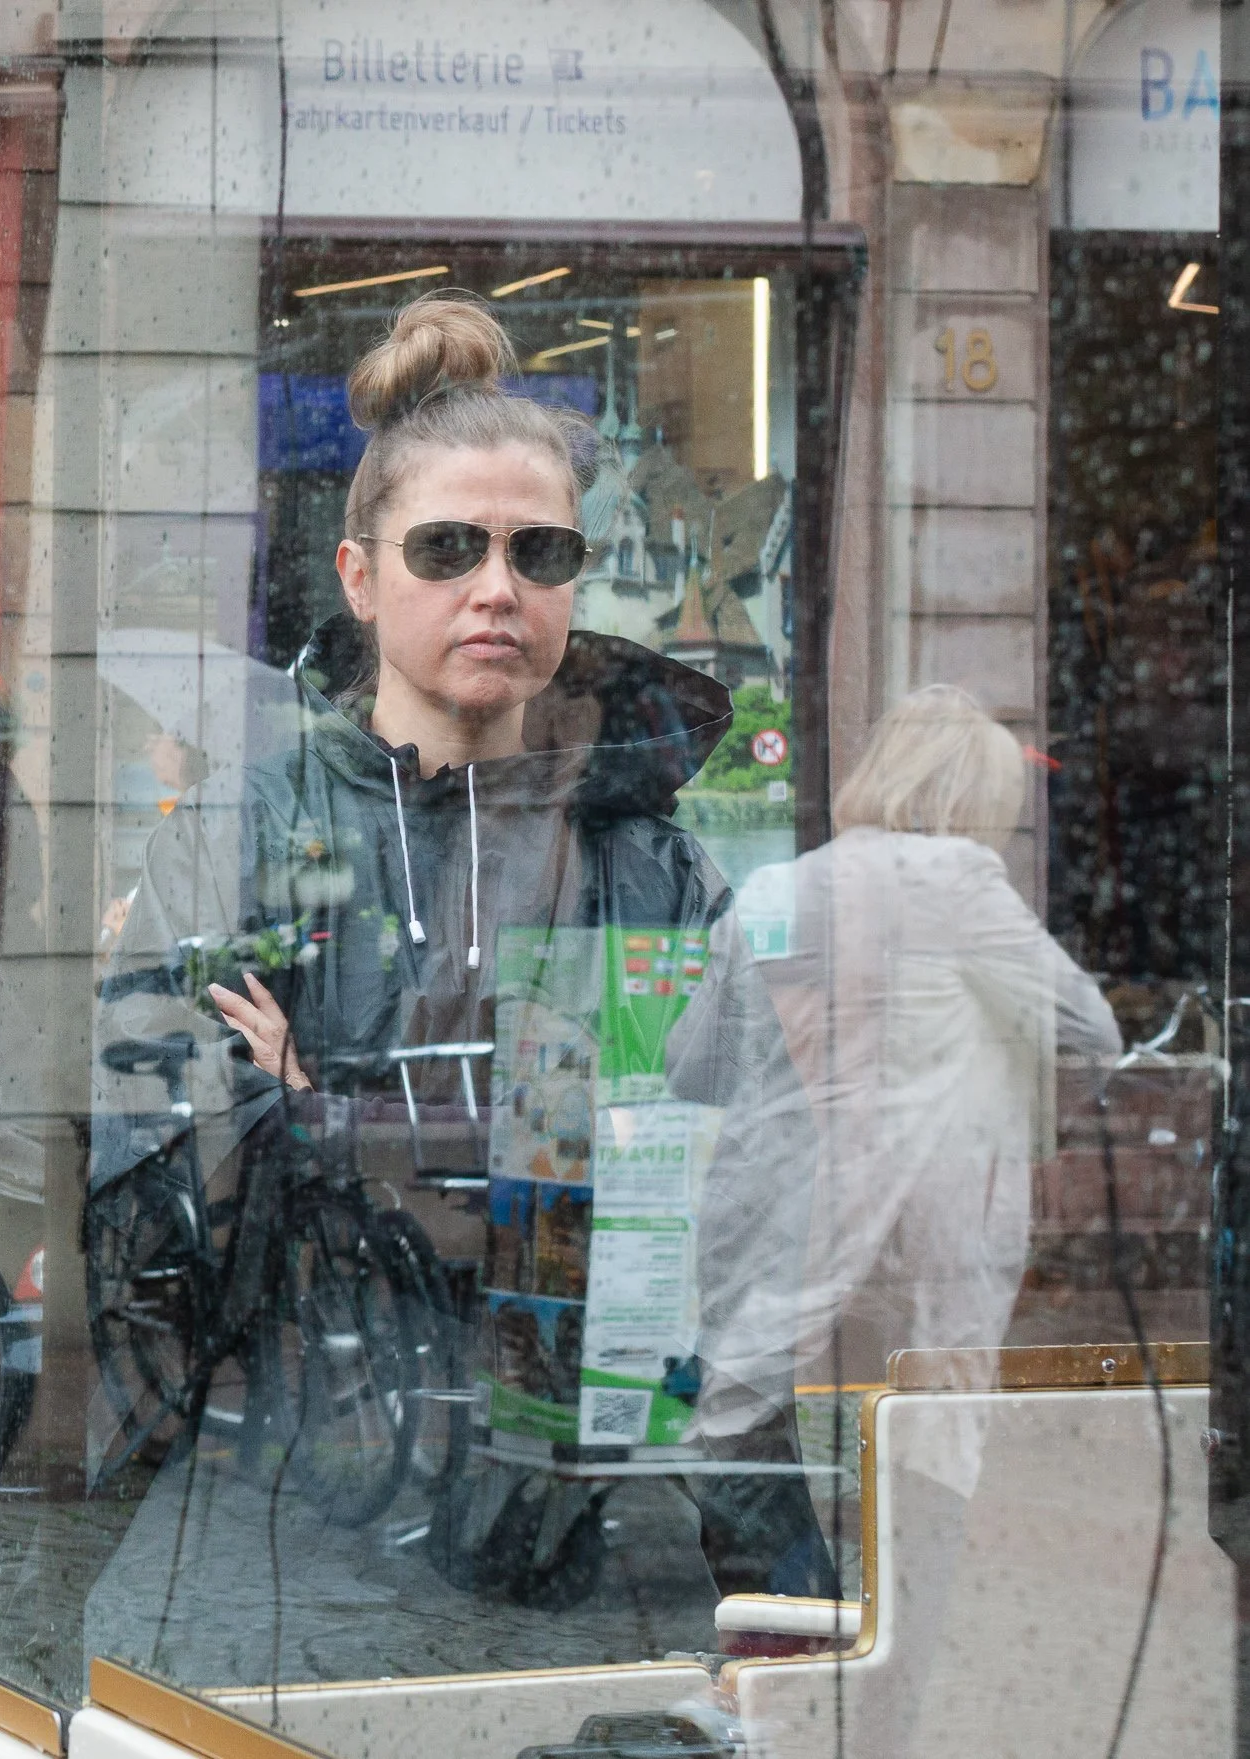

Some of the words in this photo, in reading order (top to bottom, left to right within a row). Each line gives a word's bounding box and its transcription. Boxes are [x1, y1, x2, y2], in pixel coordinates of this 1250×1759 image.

[323, 38, 525, 84] Billetterie
[519, 104, 533, 134] /
[545, 105, 627, 135] Tickets
[934, 327, 998, 393] 18
